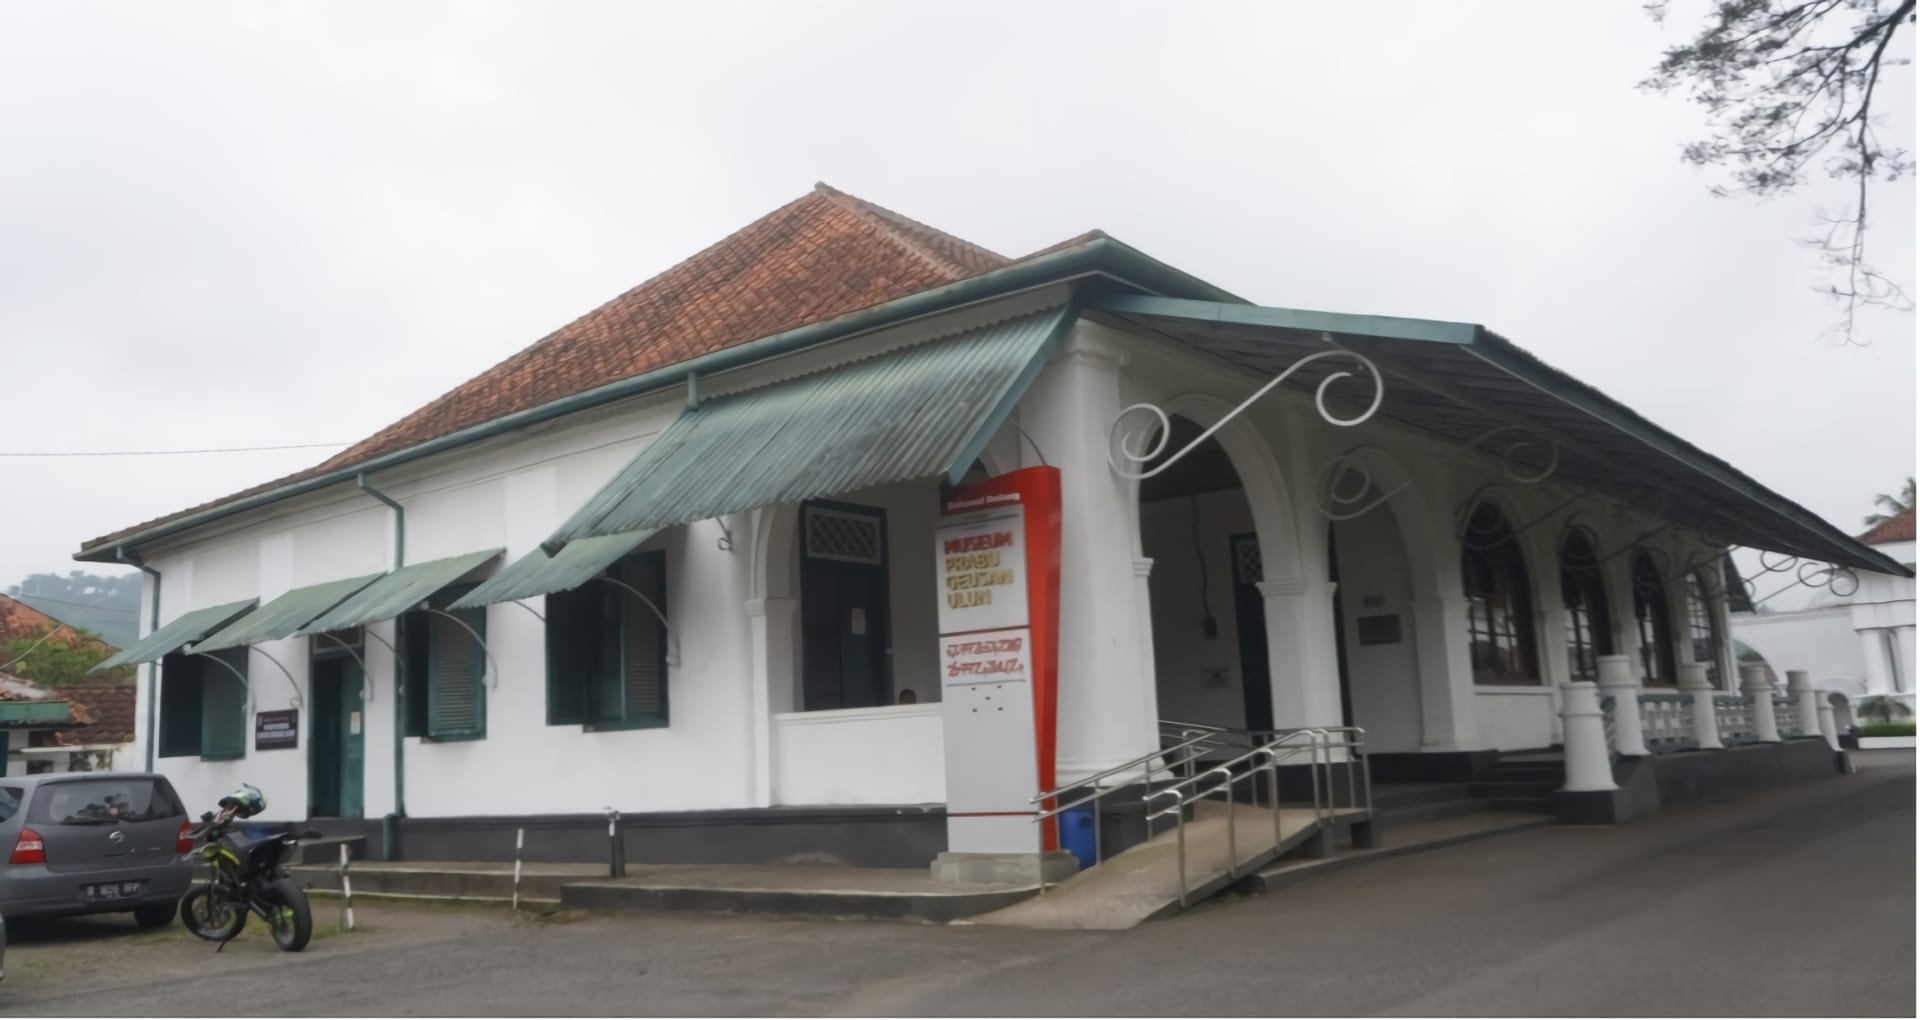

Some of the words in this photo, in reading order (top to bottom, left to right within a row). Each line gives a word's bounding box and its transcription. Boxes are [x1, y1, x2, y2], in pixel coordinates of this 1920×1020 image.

[944, 531, 1013, 554] MUSEUM
[945, 551, 1001, 573] PRABU
[947, 588, 992, 609] ULUN
